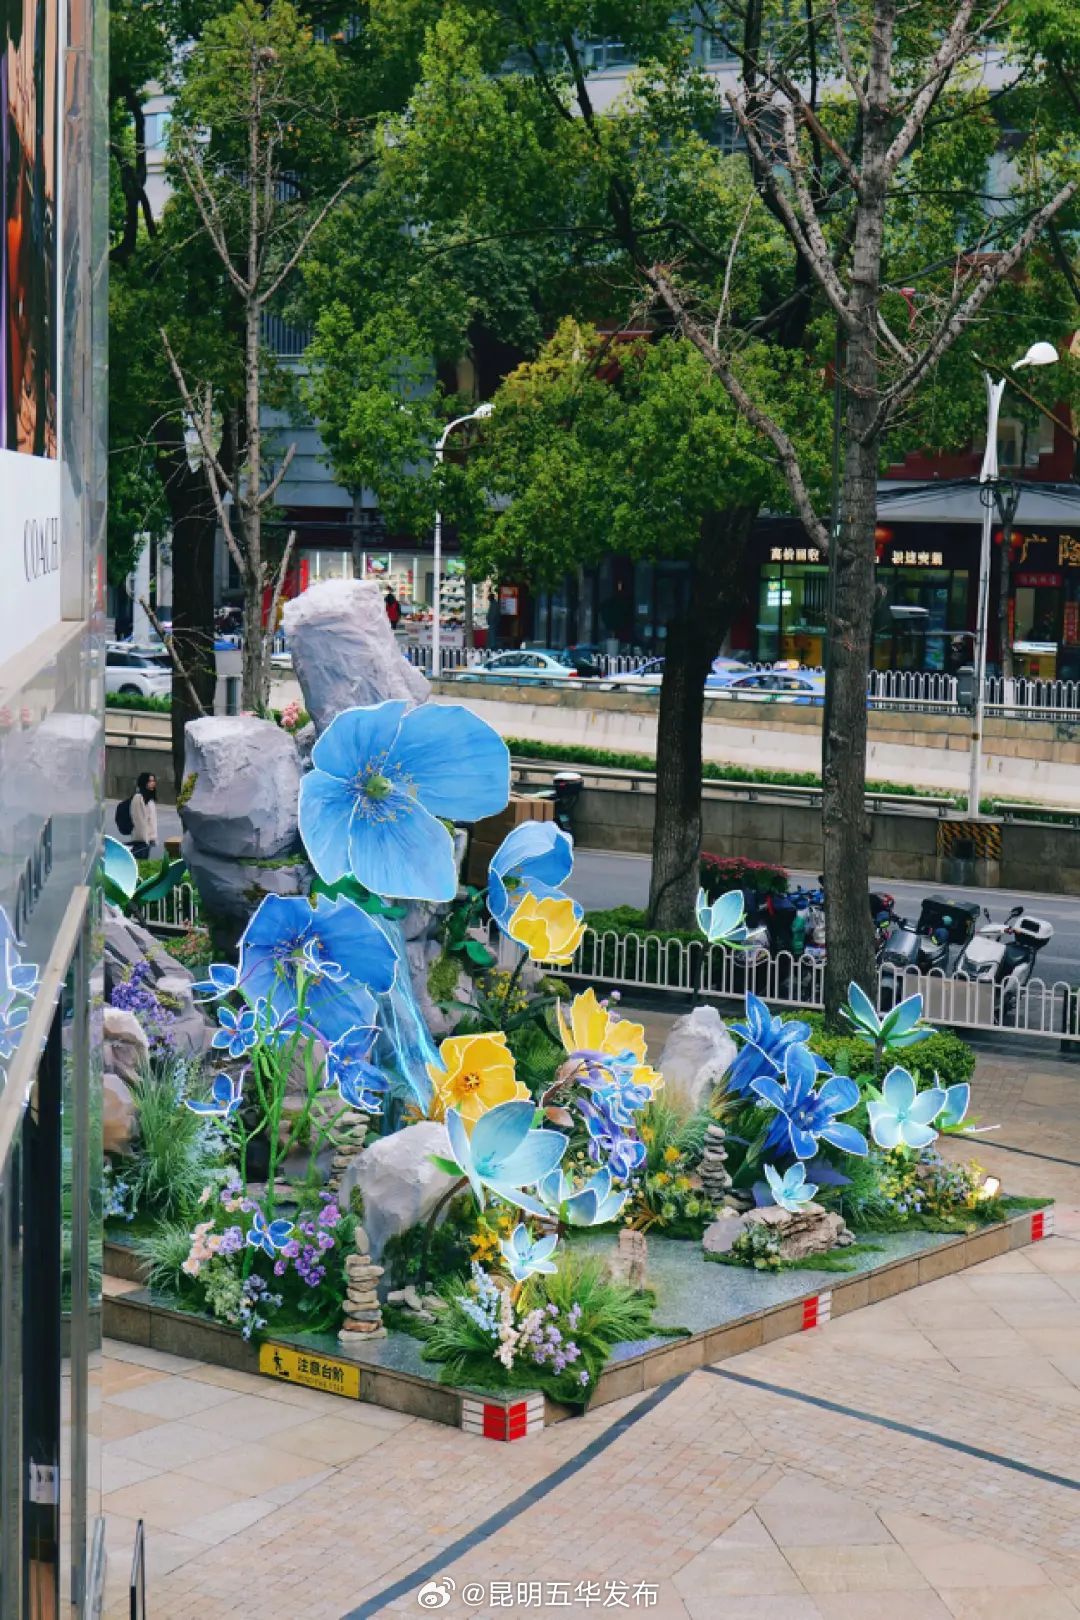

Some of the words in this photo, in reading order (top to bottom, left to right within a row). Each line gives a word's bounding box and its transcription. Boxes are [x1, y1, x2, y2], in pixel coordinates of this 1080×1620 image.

[24, 517, 59, 582] COACH
[297, 1356, 344, 1383] 注意台阶
